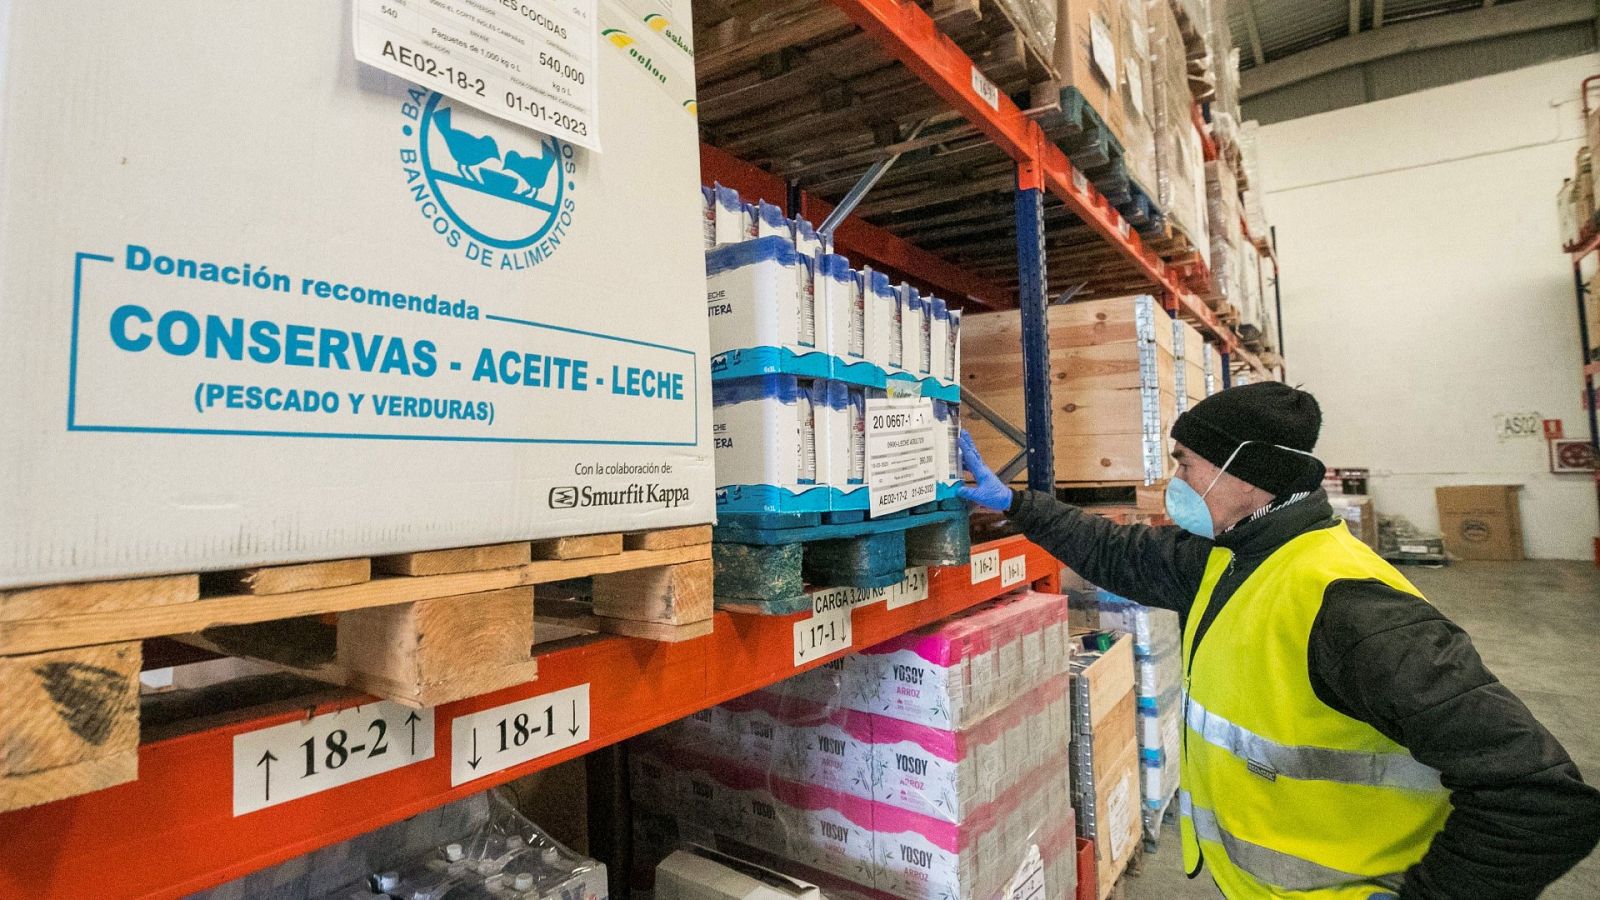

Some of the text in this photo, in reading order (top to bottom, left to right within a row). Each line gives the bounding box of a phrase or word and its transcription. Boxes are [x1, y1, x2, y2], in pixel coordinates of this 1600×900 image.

[381, 5, 398, 18] 540
[521, 5, 567, 39] COCIDAS
[431, 27, 468, 50] Paquetes
[469, 44, 479, 54] de
[540, 52, 585, 85] 540,000
[382, 40, 487, 97] AE02-18-2
[506, 91, 587, 136] 01-01-2023
[551, 81, 561, 93] kg
[567, 87, 573, 96] L
[402, 85, 429, 120] BA
[400, 148, 575, 270] BANCOS DE ALIMENTOS
[125, 244, 480, 320] Donación recomendada
[109, 304, 438, 377] CONSERVAS
[472, 347, 588, 391] ACEITE
[612, 365, 684, 400] LECHE
[194, 382, 495, 425] (PESCADO Y VERDURAS)
[873, 415, 884, 429] 20
[1505, 416, 1537, 434] AS02
[574, 461, 673, 475] Con la colaboración de:
[580, 483, 689, 508] Smurfit Kappa
[879, 490, 908, 506] AE02-17-2
[979, 556, 993, 574] 16-2
[900, 573, 919, 595] 17-2
[815, 589, 848, 613] CARGA
[810, 620, 836, 649] 17-1
[893, 664, 924, 685] YOSOY
[896, 687, 920, 698] ARROZ
[496, 705, 555, 754] 18-1
[300, 718, 389, 779] 18-2
[818, 735, 846, 757] YOSOY
[896, 753, 928, 776] YOSOY
[820, 820, 849, 843] YOSOY
[900, 844, 932, 869] YOSOY
